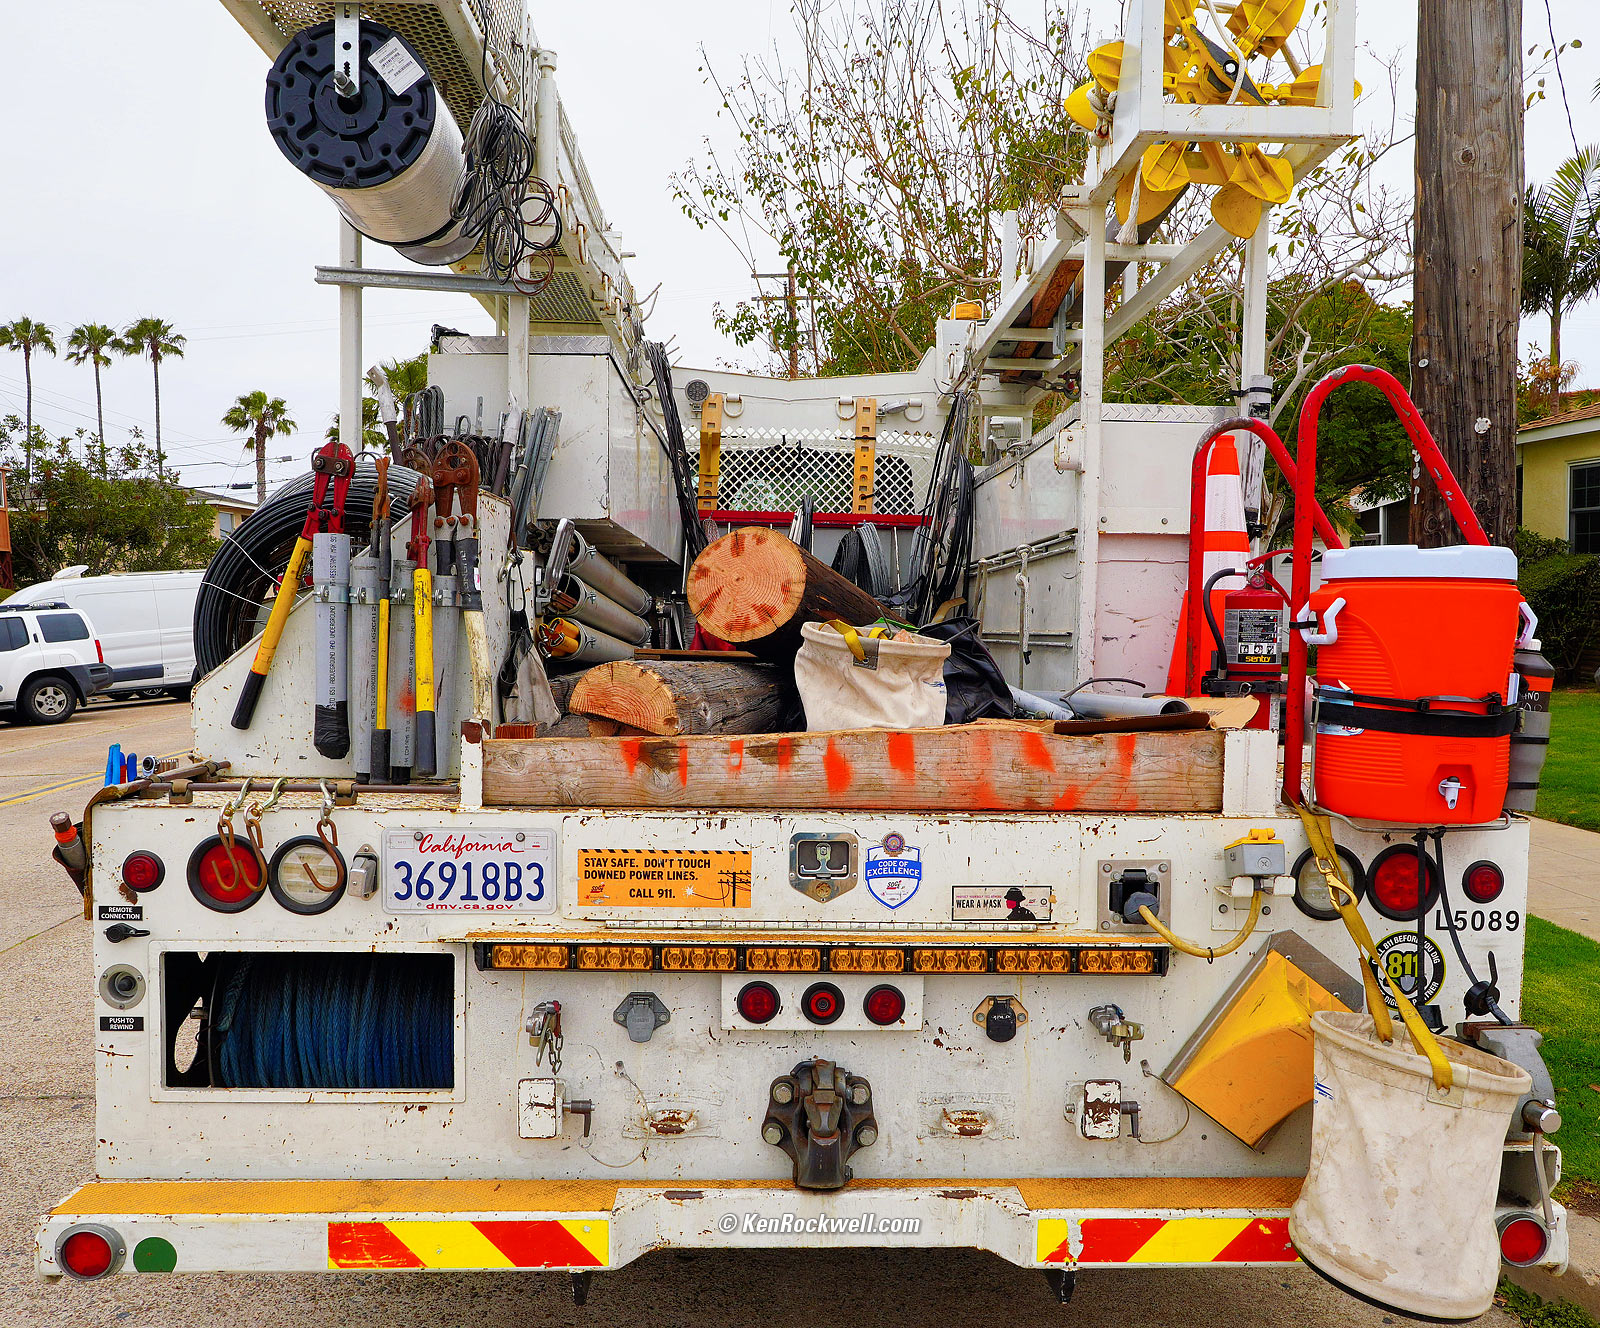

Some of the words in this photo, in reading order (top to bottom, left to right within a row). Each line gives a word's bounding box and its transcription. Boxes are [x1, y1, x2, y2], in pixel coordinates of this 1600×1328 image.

[328, 605, 337, 639] UNDERGROUND
[328, 640, 337, 650] AND
[1245, 655, 1271, 663] sentry
[419, 833, 524, 859] California
[584, 858, 609, 868] STAY
[611, 858, 639, 868] SAFE.
[644, 858, 675, 868] DON'T
[677, 858, 711, 869] TOUCH
[878, 860, 898, 868] CODE
[898, 860, 909, 868] OF
[584, 870, 626, 880] DOWNED
[629, 870, 664, 880] POWER
[667, 871, 698, 881] LINES.
[867, 867, 920, 877] EXCELLENCE
[394, 861, 545, 901] 36918B3
[629, 888, 654, 898] CALL
[657, 888, 676, 898] 911.
[426, 903, 514, 911] dmv.ca.gov
[956, 899, 975, 909] WEAR
[976, 899, 982, 909] A
[983, 899, 1002, 909] MASK
[100, 912, 141, 920] CONNECTION
[1435, 909, 1520, 932] L5089
[1383, 938, 1395, 950] 811
[1430, 950, 1441, 964] DIG
[1387, 952, 1418, 978] 811
